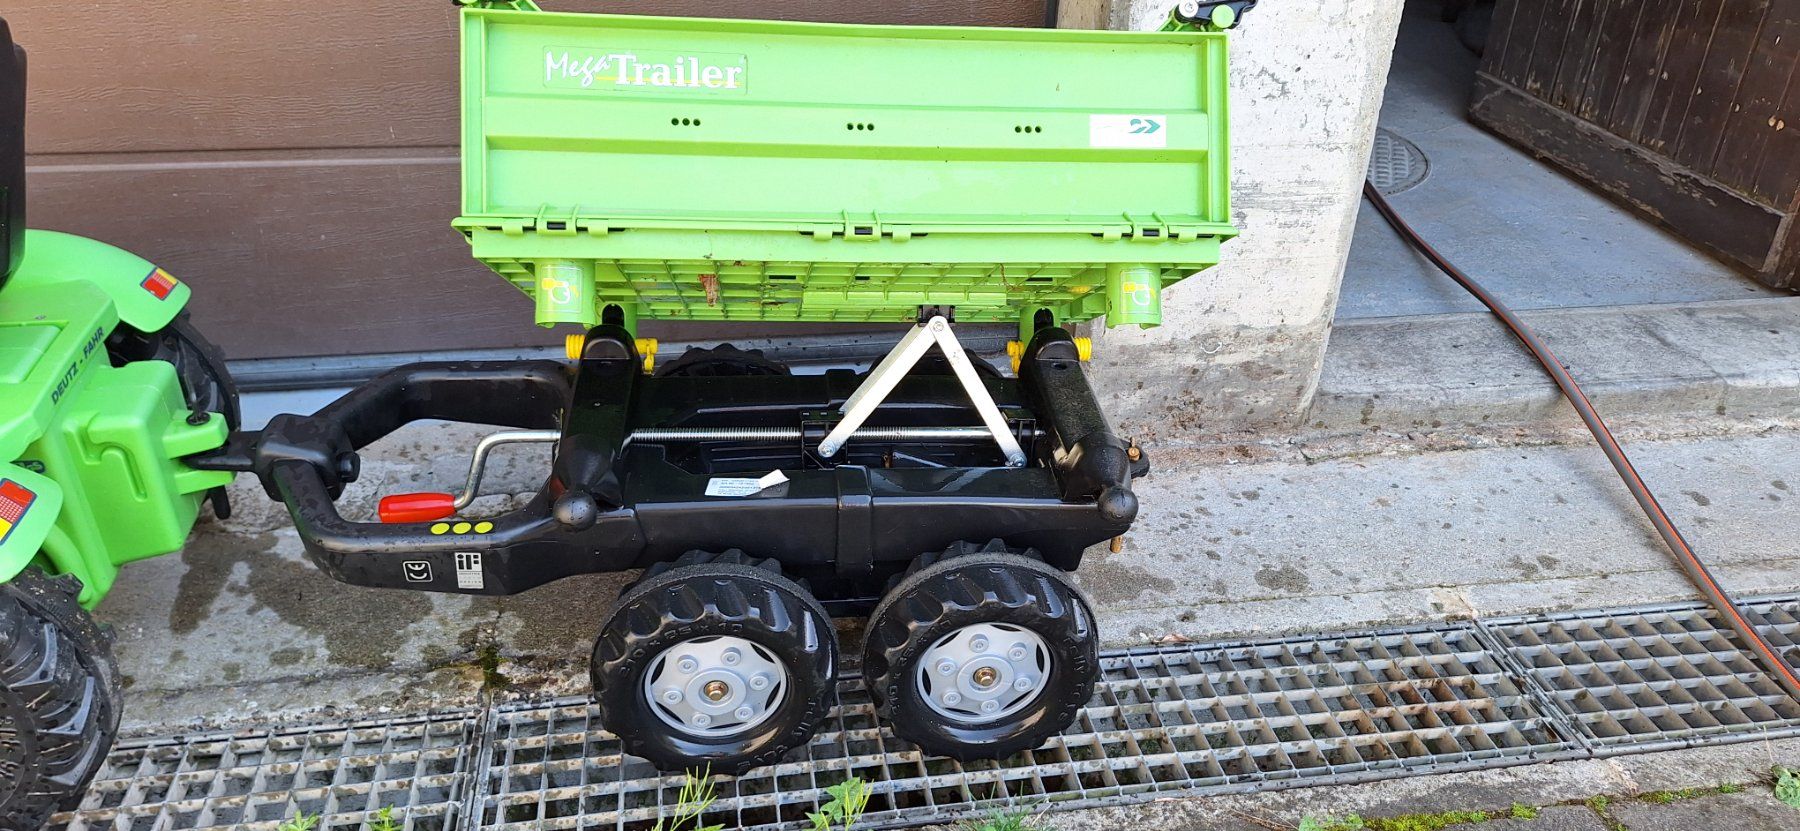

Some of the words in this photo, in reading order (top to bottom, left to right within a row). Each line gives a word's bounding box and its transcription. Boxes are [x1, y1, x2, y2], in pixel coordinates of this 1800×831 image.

[545, 51, 610, 88] Mega
[608, 53, 743, 89] Trailer
[51, 361, 79, 405] DEUTZ
[83, 326, 104, 359] FAHR
